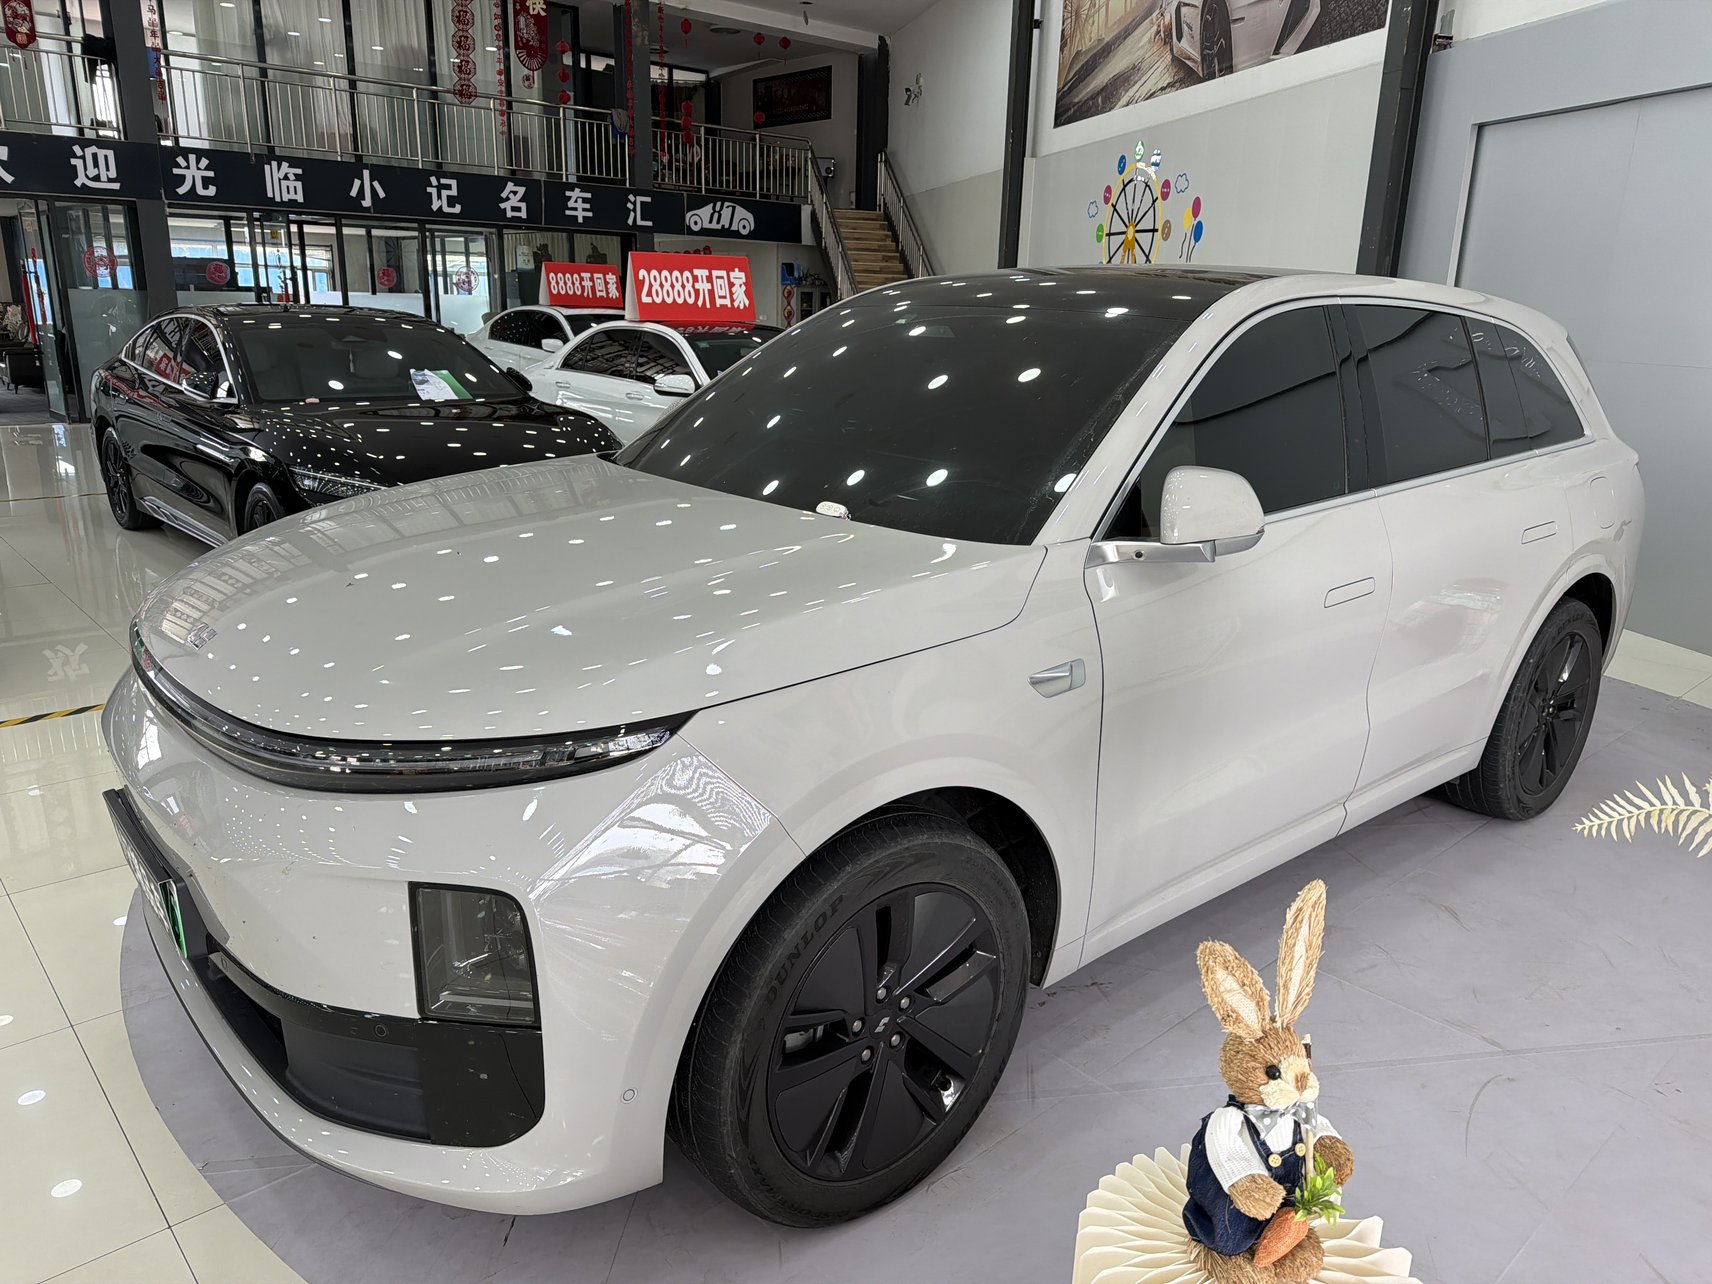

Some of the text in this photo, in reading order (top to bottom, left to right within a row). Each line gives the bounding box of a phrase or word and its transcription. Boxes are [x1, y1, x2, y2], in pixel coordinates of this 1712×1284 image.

[456, 10, 470, 26] 福
[456, 34, 470, 51] 福
[457, 59, 471, 76] 福
[0, 144, 653, 227] 迎光临小记名车汇
[549, 272, 619, 299] 8888开回家
[638, 268, 750, 310] 28888开回家
[766, 894, 845, 1006] DUNLOP
